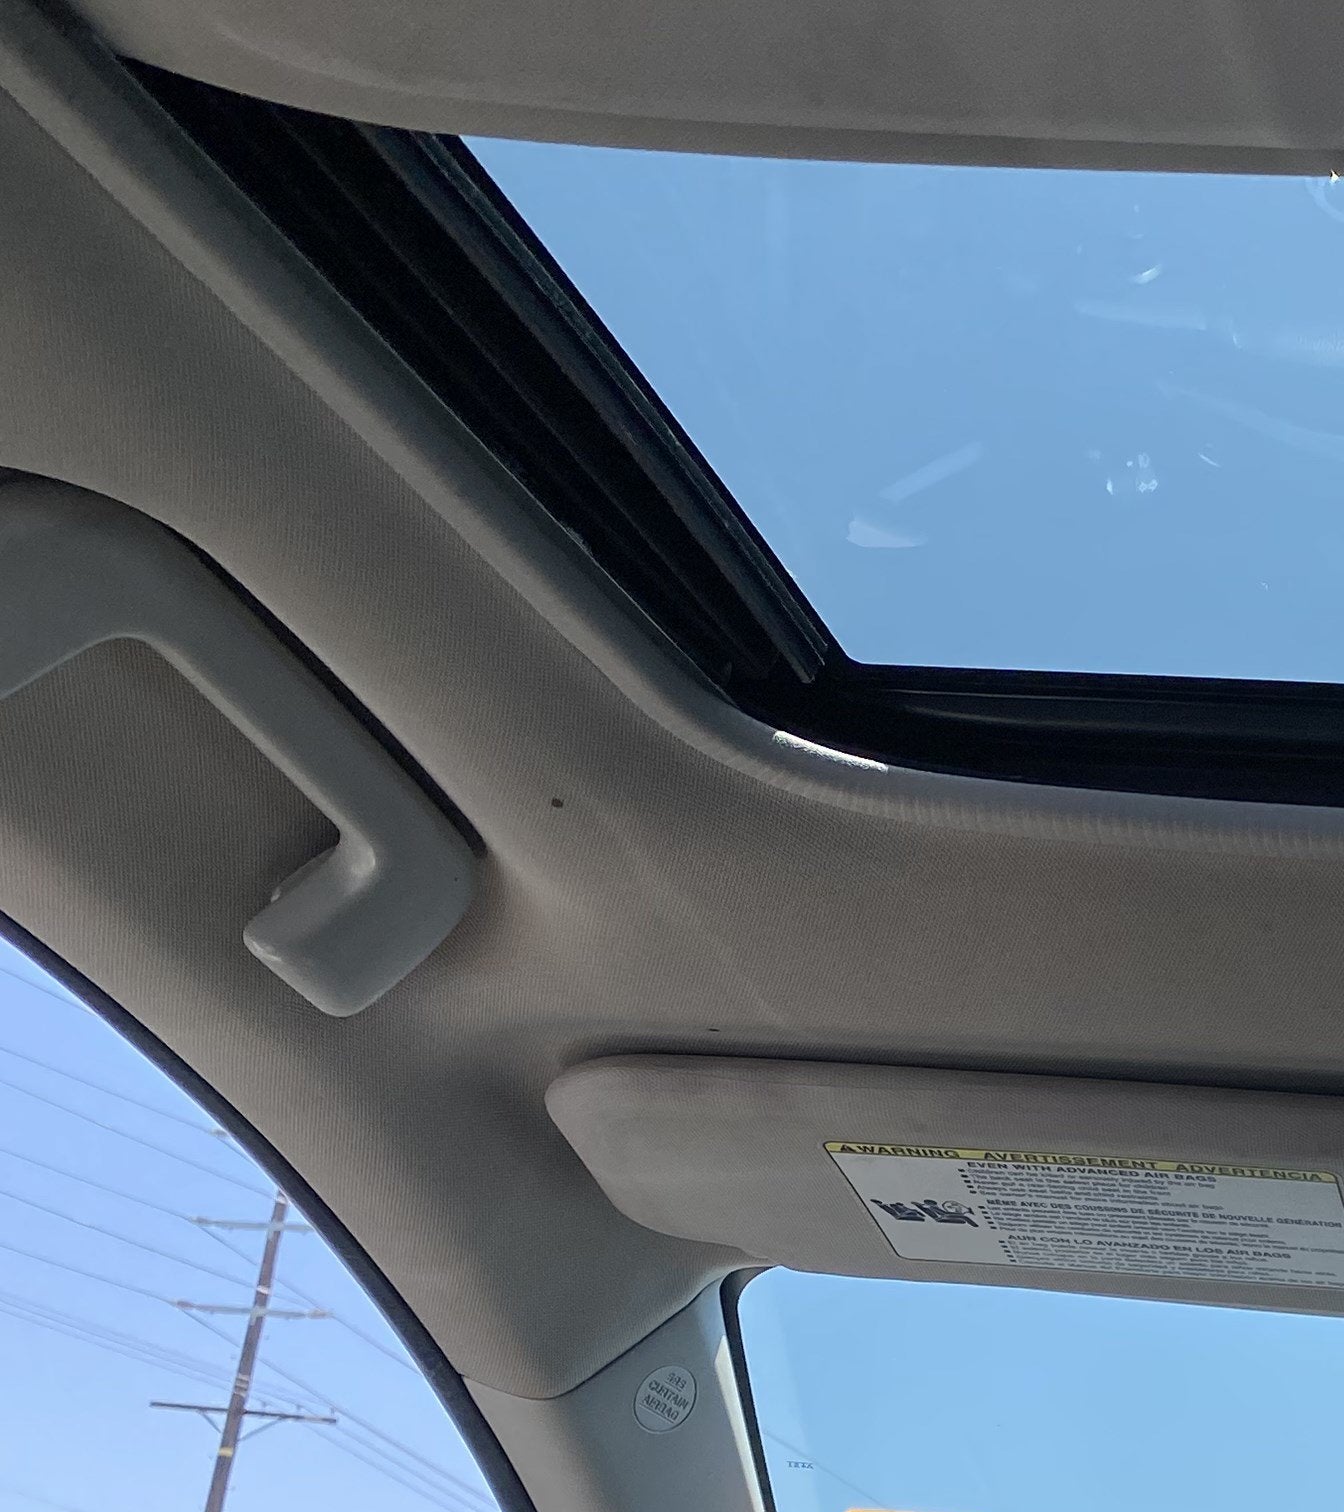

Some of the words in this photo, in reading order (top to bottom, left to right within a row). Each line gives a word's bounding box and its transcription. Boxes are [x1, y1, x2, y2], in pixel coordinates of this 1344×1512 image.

[856, 1144, 960, 1159] WARNING
[984, 1151, 1157, 1170] AVERTISSEMENT
[1175, 1164, 1322, 1181] ADVERTENCIA
[967, 1161, 1008, 1169] EVEN
[1057, 1167, 1140, 1178] ADVANCED
[1144, 1171, 1171, 1180] AIR
[1174, 1173, 1217, 1183] BAGS
